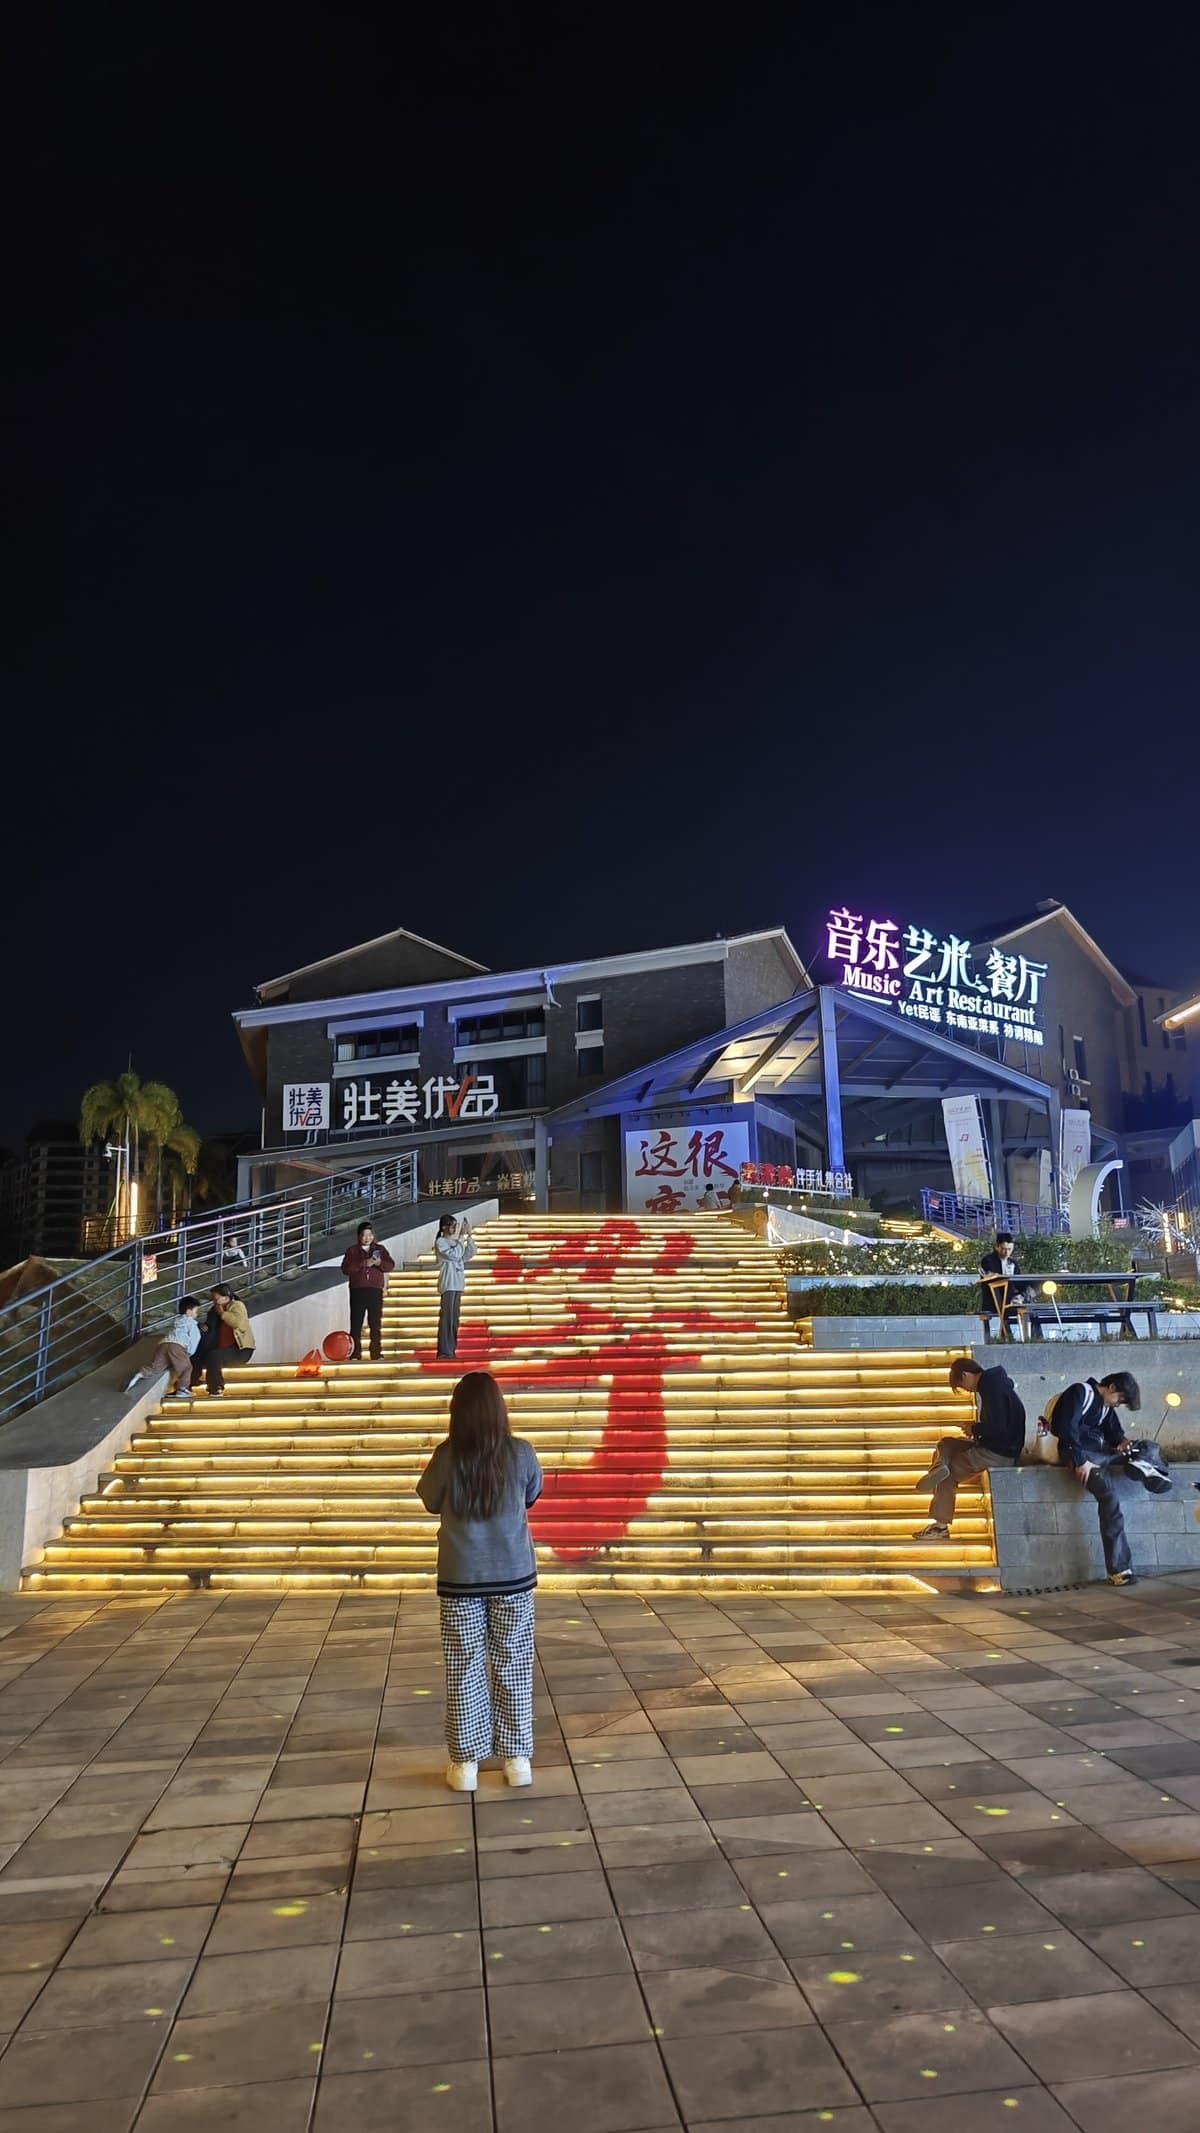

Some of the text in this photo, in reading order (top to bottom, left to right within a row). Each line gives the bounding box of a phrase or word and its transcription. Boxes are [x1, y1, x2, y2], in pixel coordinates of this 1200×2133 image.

[825, 906, 1049, 1005] 音乐艺术餐厅
[842, 964, 1036, 1026] Music Art Restaurant
[289, 1087, 323, 1109] 壮美
[343, 1075, 499, 1130] 壮美优品
[635, 1130, 739, 1179] 这很
